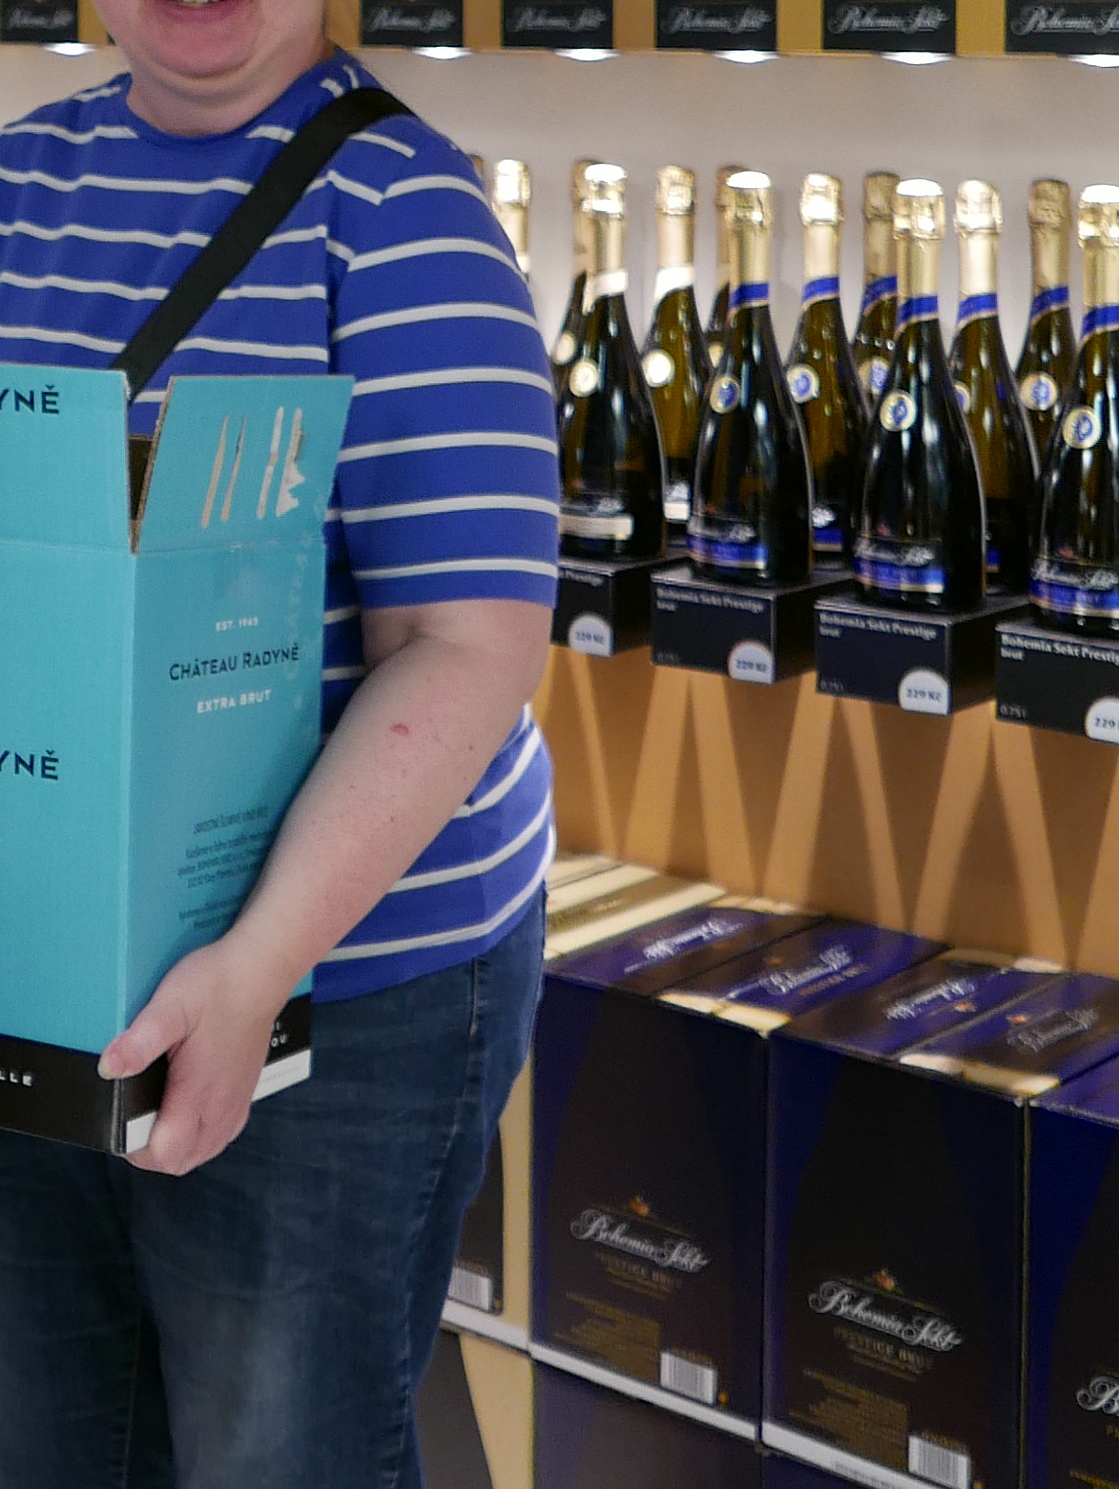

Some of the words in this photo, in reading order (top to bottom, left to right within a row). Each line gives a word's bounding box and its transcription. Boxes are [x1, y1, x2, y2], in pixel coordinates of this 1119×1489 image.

[819, 613, 865, 631] Bohemia
[867, 617, 890, 633] Sekt
[892, 621, 936, 640] Prestige
[1000, 647, 1023, 661] brut
[1001, 632, 1052, 653] Bohemia
[1054, 640, 1079, 658] Sekt
[1081, 644, 1119, 668] Prestig
[169, 655, 237, 681] CHÂTEAU
[196, 697, 236, 714] EXTRA
[239, 688, 272, 706] BRUT
[570, 1209, 657, 1262] Bohemia
[808, 1279, 905, 1345] Bohemia
[902, 1314, 964, 1353] Sekt
